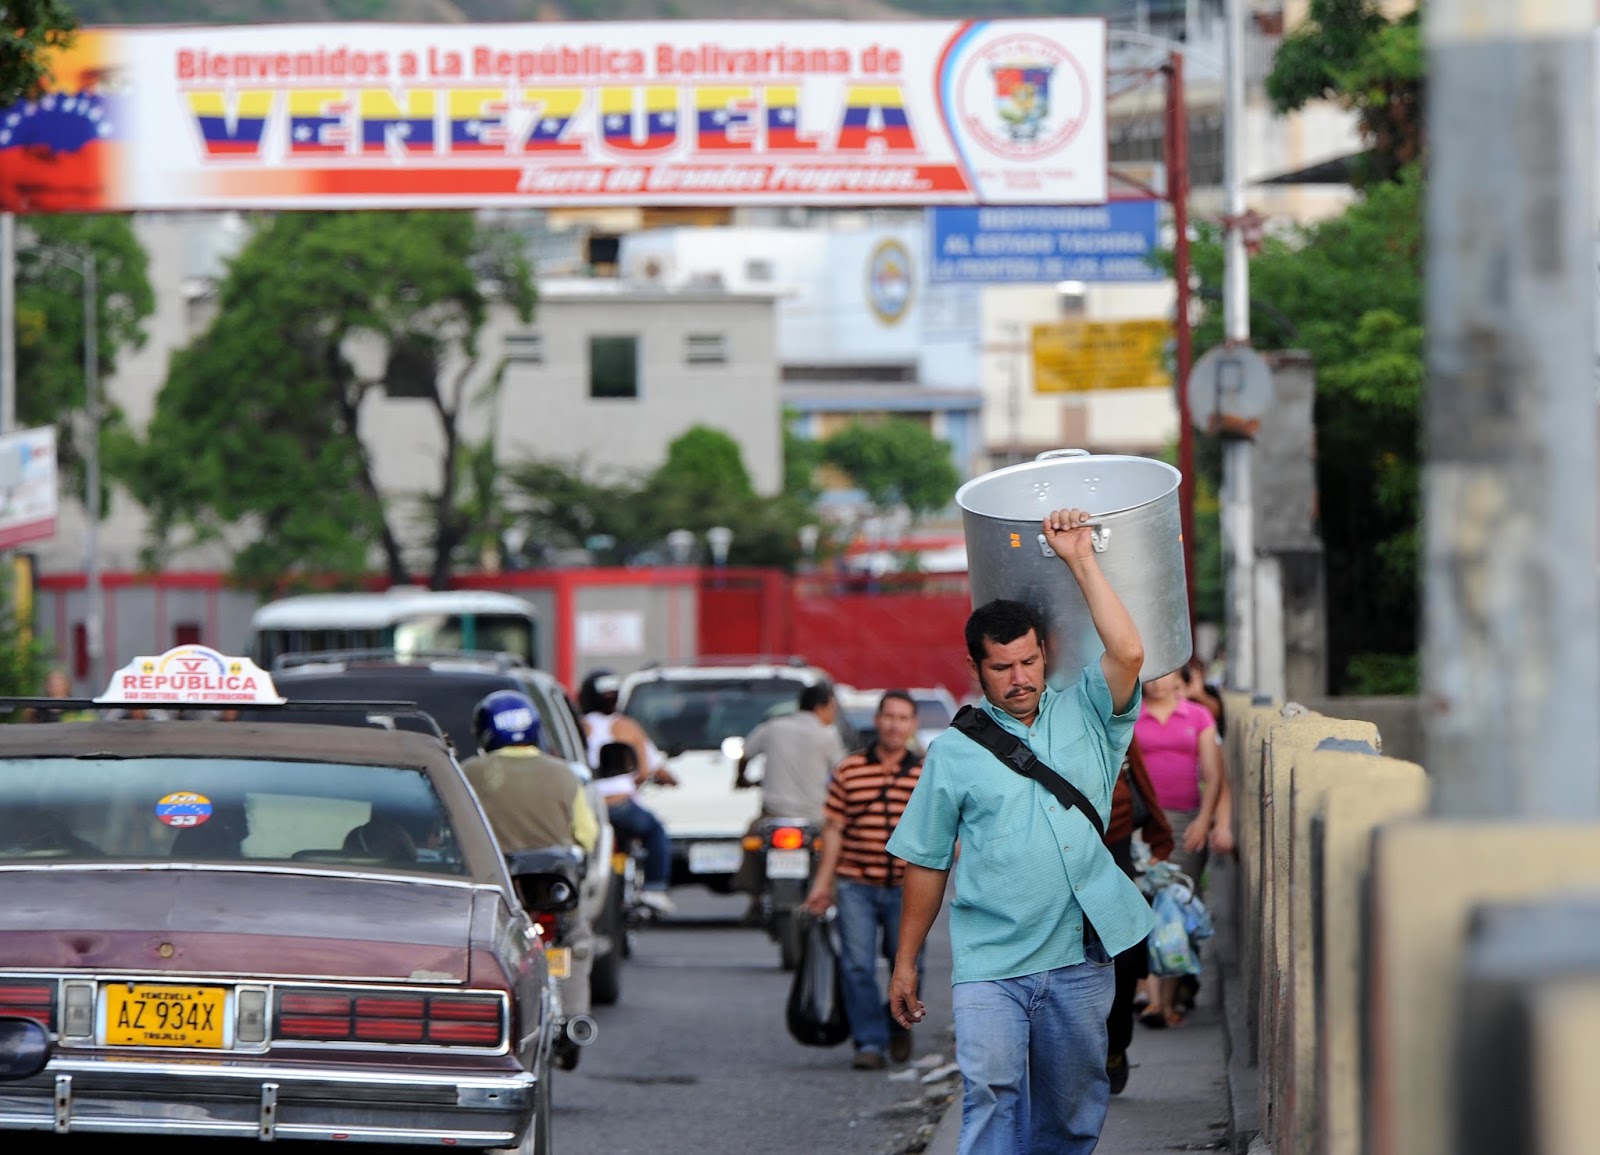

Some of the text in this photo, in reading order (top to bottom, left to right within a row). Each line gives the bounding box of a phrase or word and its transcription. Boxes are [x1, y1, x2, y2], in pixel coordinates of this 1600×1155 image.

[176, 44, 902, 81] Bienvenidos a La República Bolivariana de
[183, 85, 918, 157] VENEZUELA
[122, 675, 257, 690] REPUBLICA
[170, 815, 197, 826] 33
[141, 992, 192, 1001] VENEZUELA
[117, 1000, 215, 1031] AZ 934X
